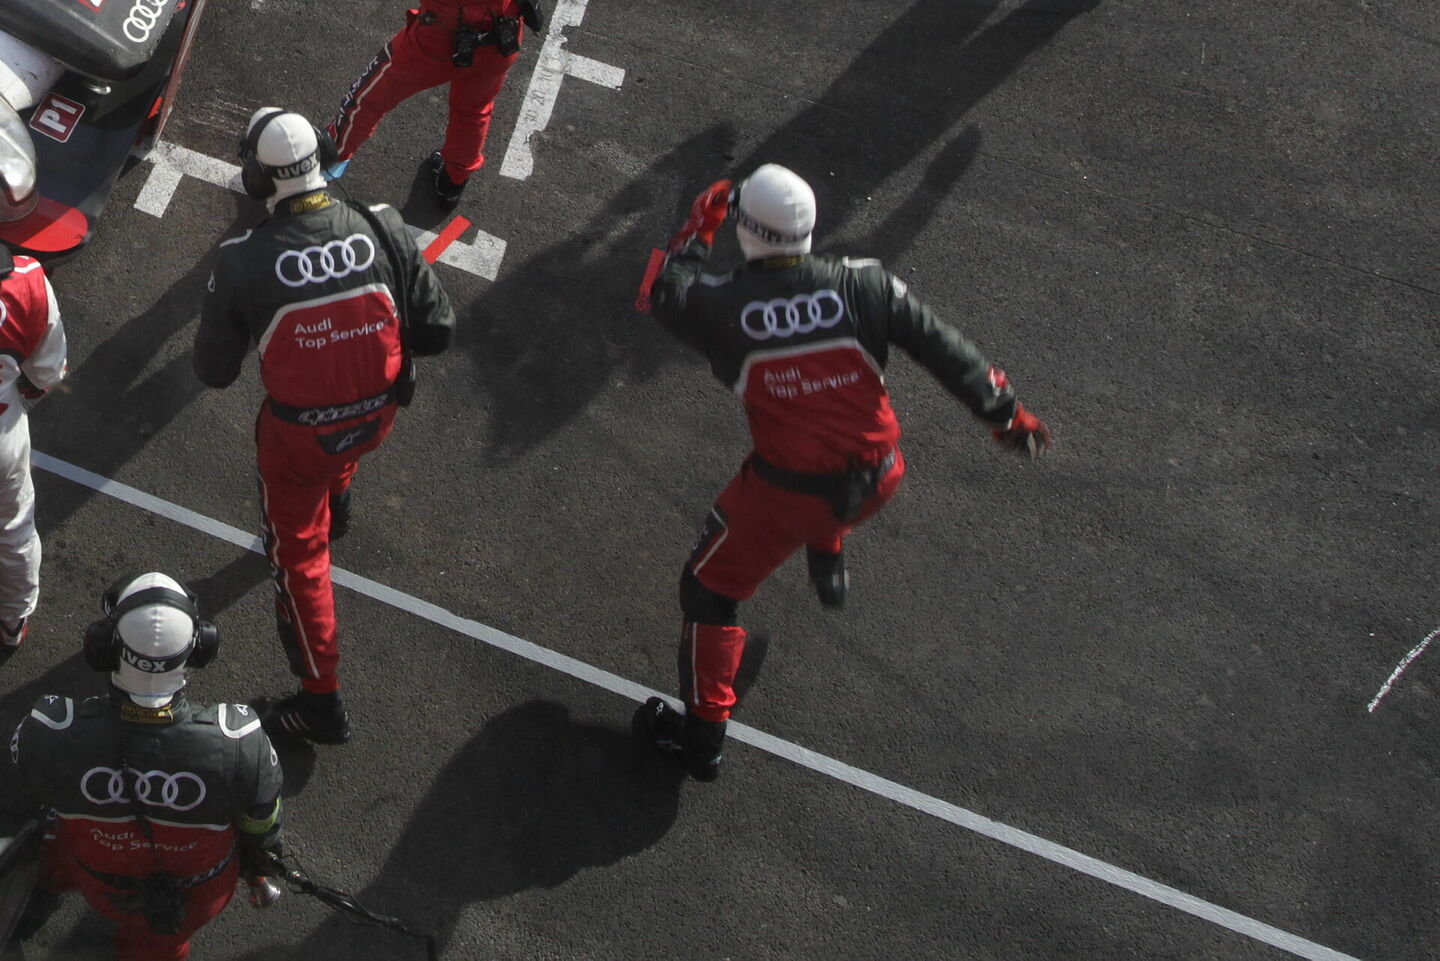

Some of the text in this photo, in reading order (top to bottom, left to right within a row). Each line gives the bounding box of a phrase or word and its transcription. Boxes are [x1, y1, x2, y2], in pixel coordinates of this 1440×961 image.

[39, 98, 77, 134] P1
[276, 152, 317, 178] uvex
[294, 317, 332, 335] Audi
[295, 320, 385, 350] Top Service
[764, 366, 801, 384] Audi
[767, 371, 859, 399] Top Service
